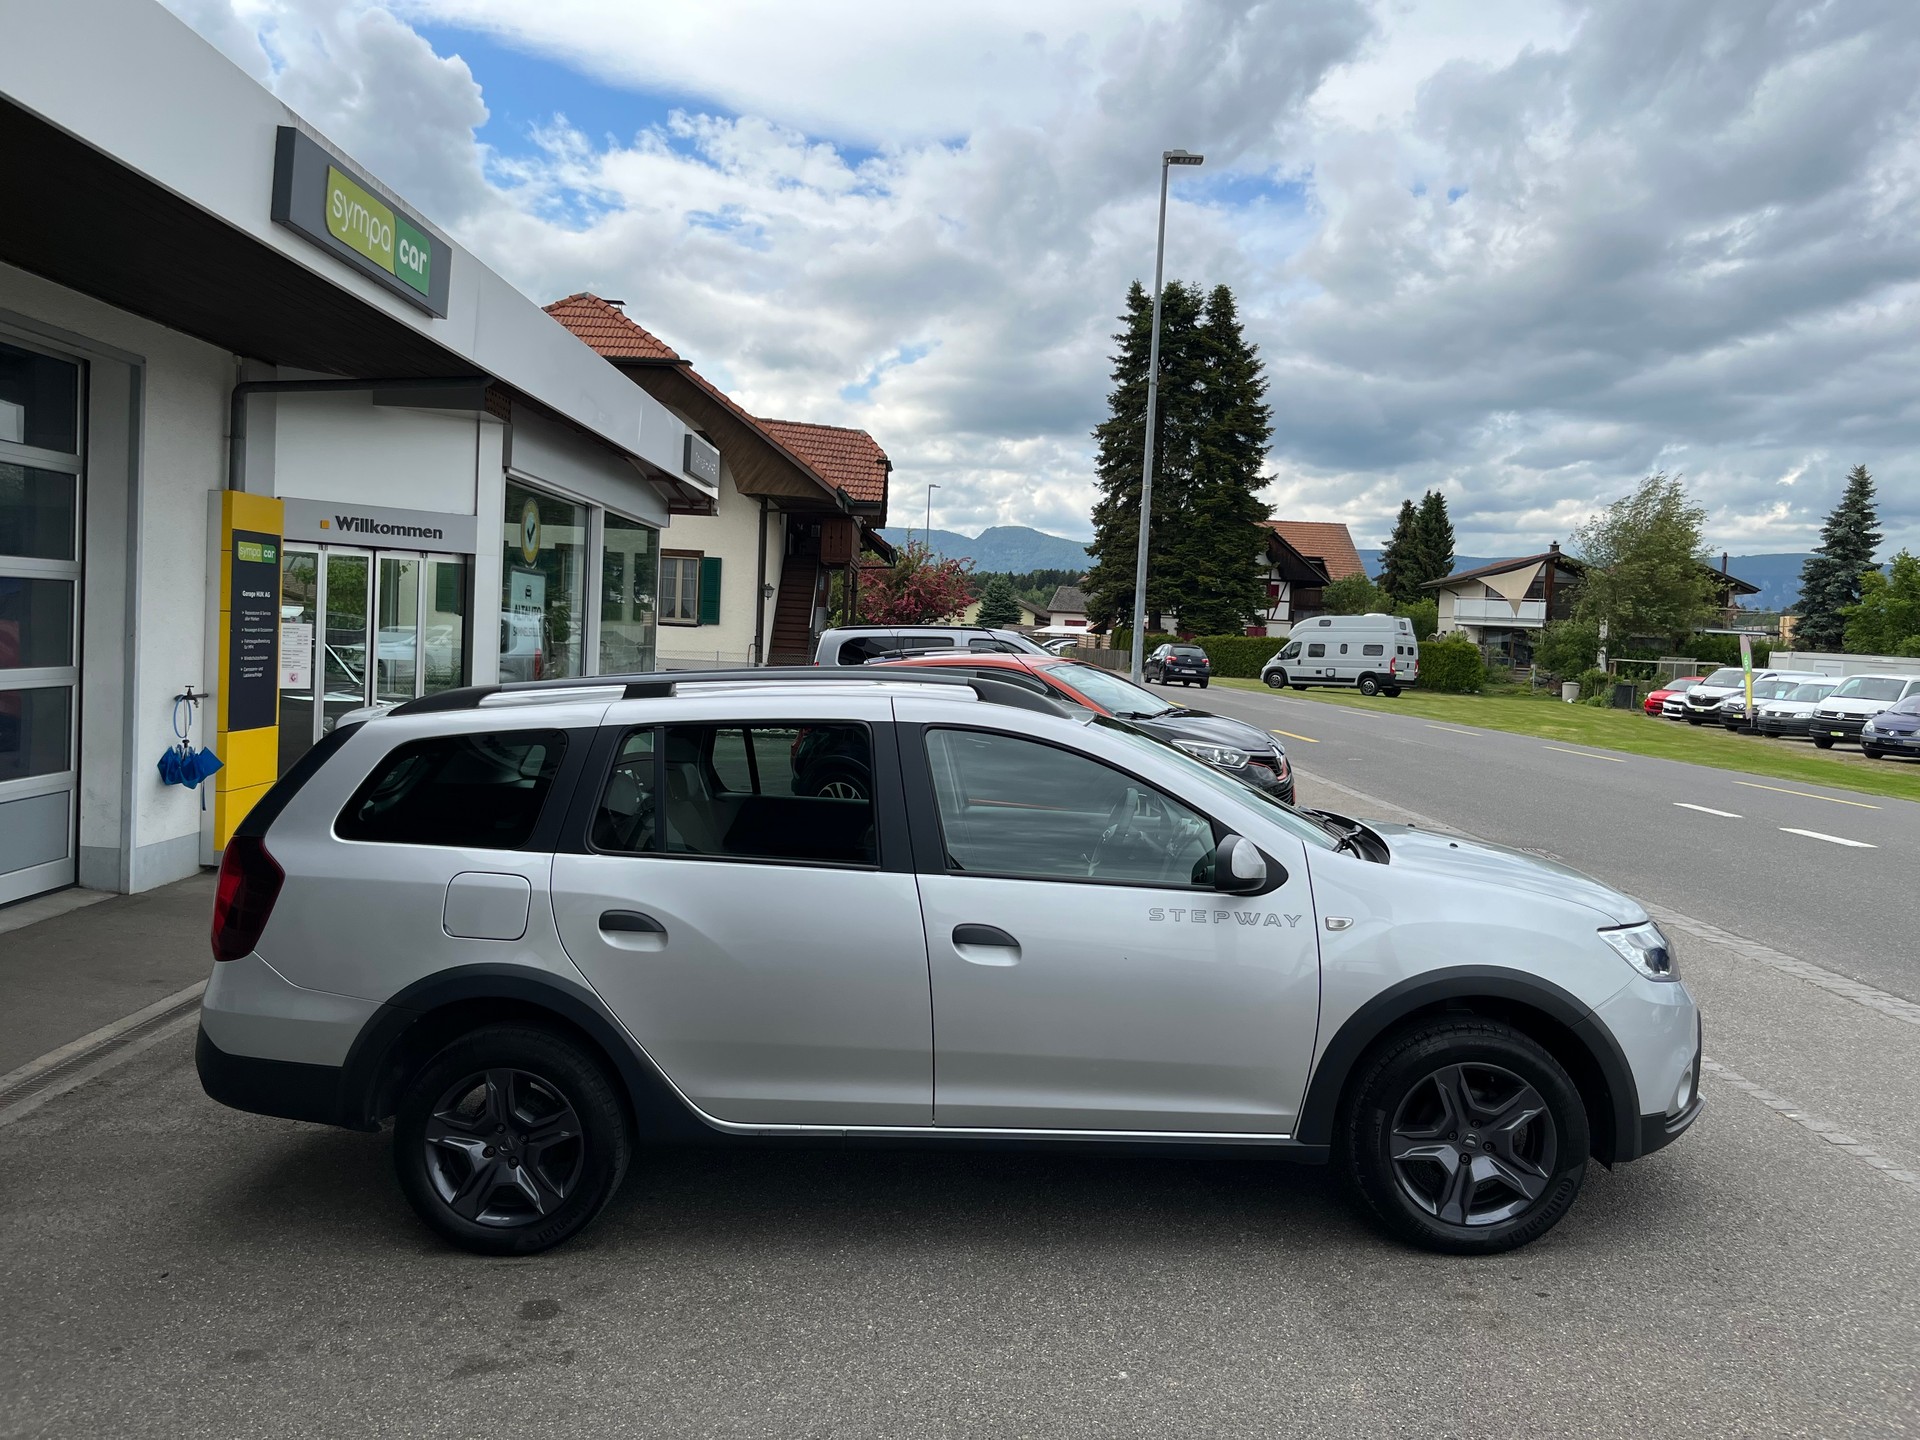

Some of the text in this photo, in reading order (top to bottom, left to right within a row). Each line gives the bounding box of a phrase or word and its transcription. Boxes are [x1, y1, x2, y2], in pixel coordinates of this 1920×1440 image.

[332, 189, 427, 275] sympa car
[334, 515, 443, 539] Willkommen
[239, 546, 275, 559] sympa car
[1148, 907, 1302, 928] STEPWAY
